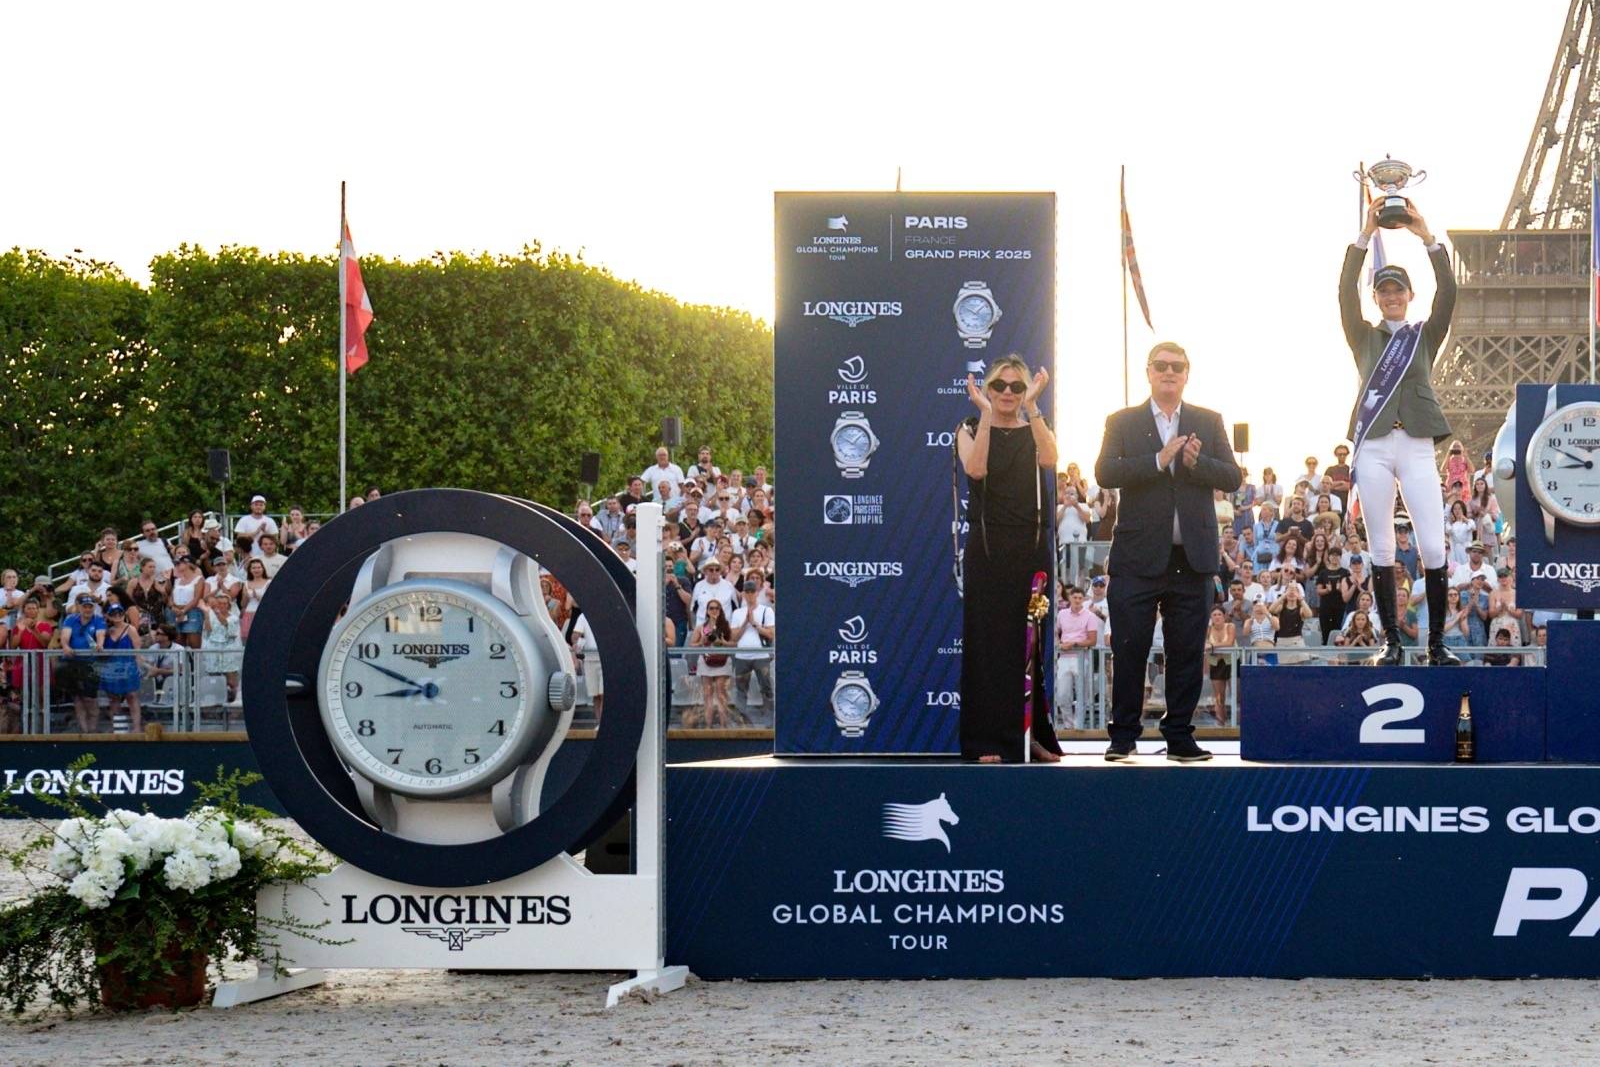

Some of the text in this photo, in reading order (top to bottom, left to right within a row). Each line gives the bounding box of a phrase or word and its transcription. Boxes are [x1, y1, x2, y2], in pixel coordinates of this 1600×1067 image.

[905, 216, 968, 229] PARIS
[905, 236, 956, 245] FRANCE
[905, 250, 1032, 259] GRAND PRIX 2025
[804, 302, 902, 316] LONGINES
[829, 390, 877, 404] PARIS
[854, 495, 883, 505] LONGINES
[854, 506, 883, 514] PARIS EIFFEL
[854, 515, 883, 525] JUMPING
[804, 562, 903, 576] LONGINES
[420, 606, 442, 622] 12
[385, 616, 399, 633] 11
[468, 617, 474, 632] 1
[358, 643, 380, 659] 10
[393, 643, 470, 655] LONGINES
[489, 643, 506, 660] 2
[829, 650, 877, 663] PARIS
[345, 681, 363, 699] 9
[499, 681, 518, 699] 3
[1359, 682, 1425, 744] 2
[357, 719, 376, 736] 8
[487, 719, 507, 736] 4
[387, 748, 403, 765] 7
[464, 748, 480, 765] 5
[425, 758, 442, 775] 6
[4, 769, 184, 795] LONGINES
[1247, 805, 1490, 833] LONGINES
[833, 869, 1005, 894] LONGINES
[341, 895, 571, 925] LONGINES
[772, 904, 1064, 924] GLOBAL CHAMPIONS
[889, 935, 948, 951] TOUR
